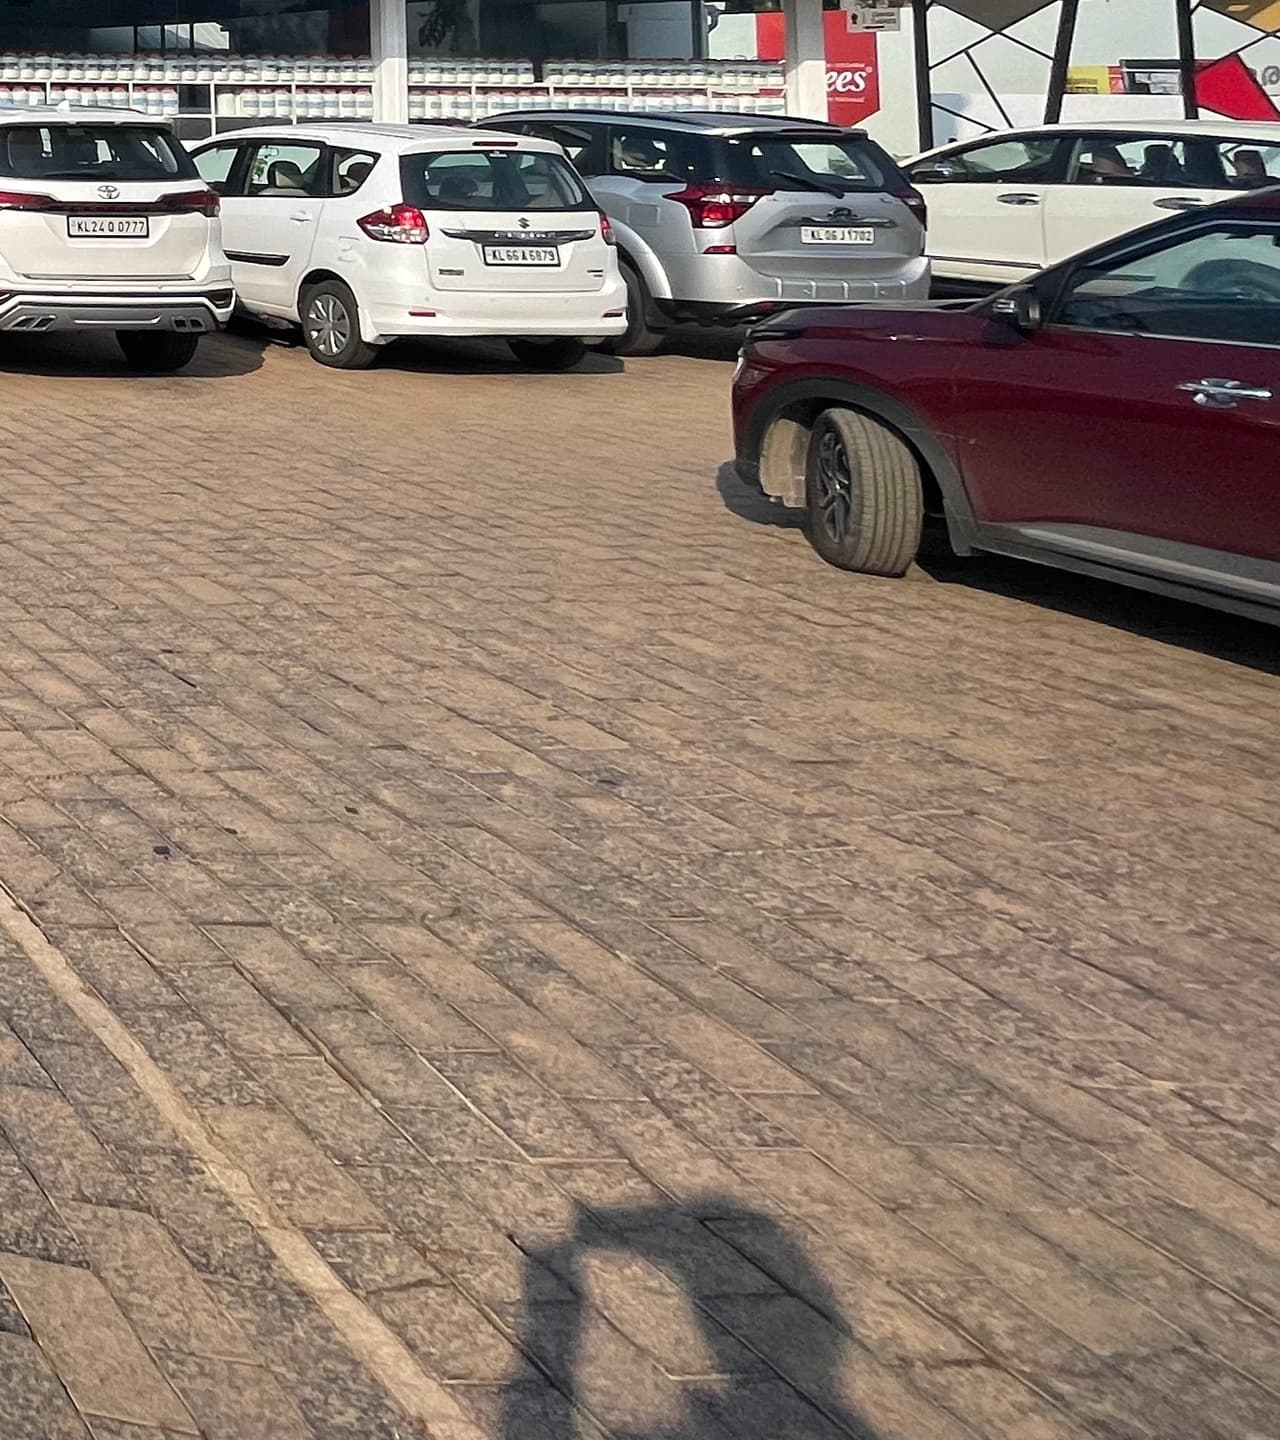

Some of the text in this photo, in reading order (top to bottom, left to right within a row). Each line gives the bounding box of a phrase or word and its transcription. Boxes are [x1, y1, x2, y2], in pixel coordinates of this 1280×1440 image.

[825, 70, 867, 92] ees
[77, 222, 90, 232] KL
[91, 221, 104, 232] 24
[118, 221, 144, 232] 0777
[493, 250, 504, 260] KL
